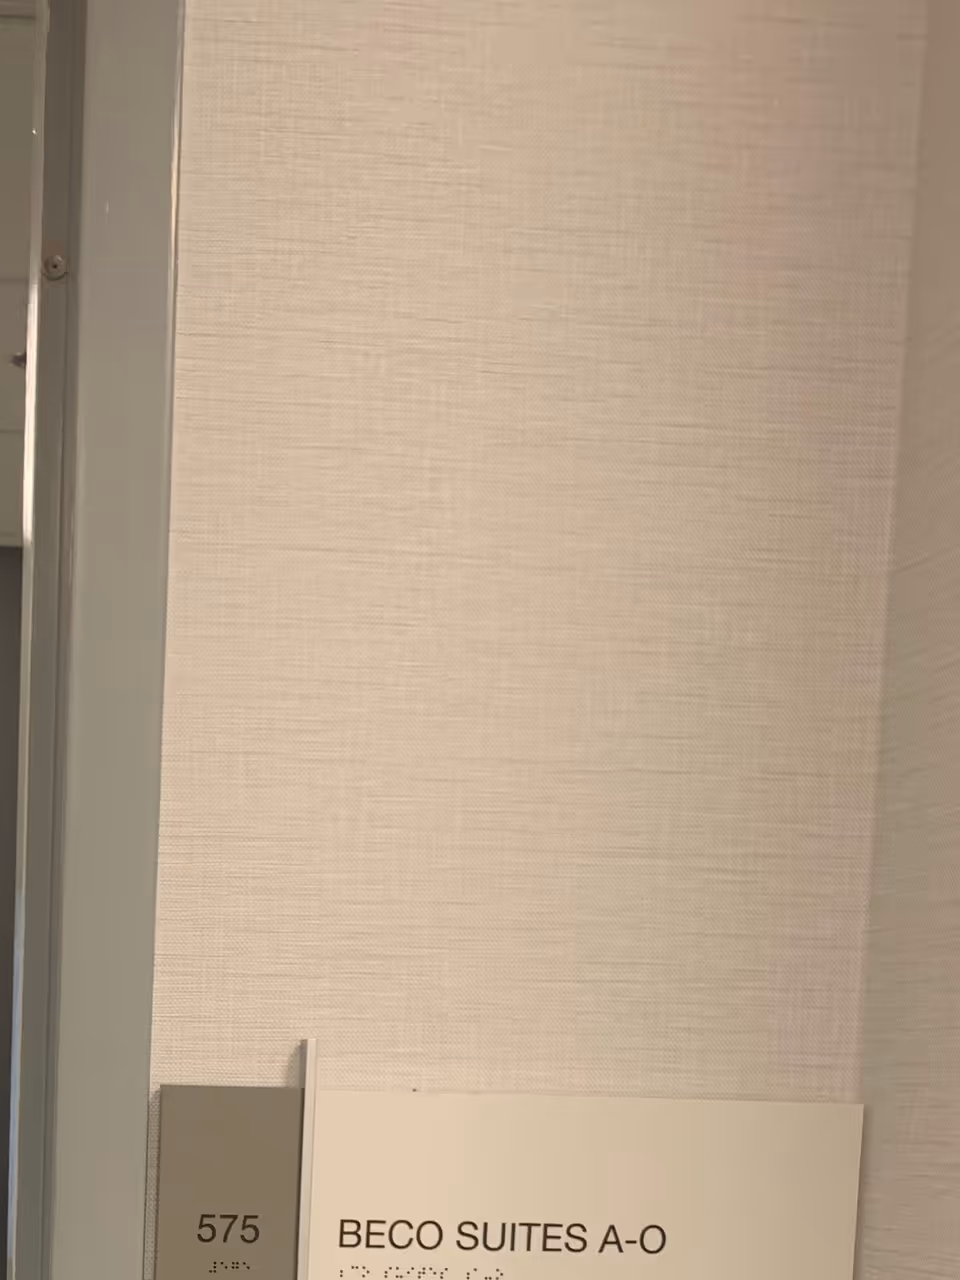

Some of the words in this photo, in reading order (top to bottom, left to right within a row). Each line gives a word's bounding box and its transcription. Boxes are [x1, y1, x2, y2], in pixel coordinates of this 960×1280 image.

[195, 1213, 261, 1245] 575
[338, 1218, 444, 1251] BECO
[454, 1220, 589, 1254] SUITES
[598, 1223, 668, 1255] A-O
